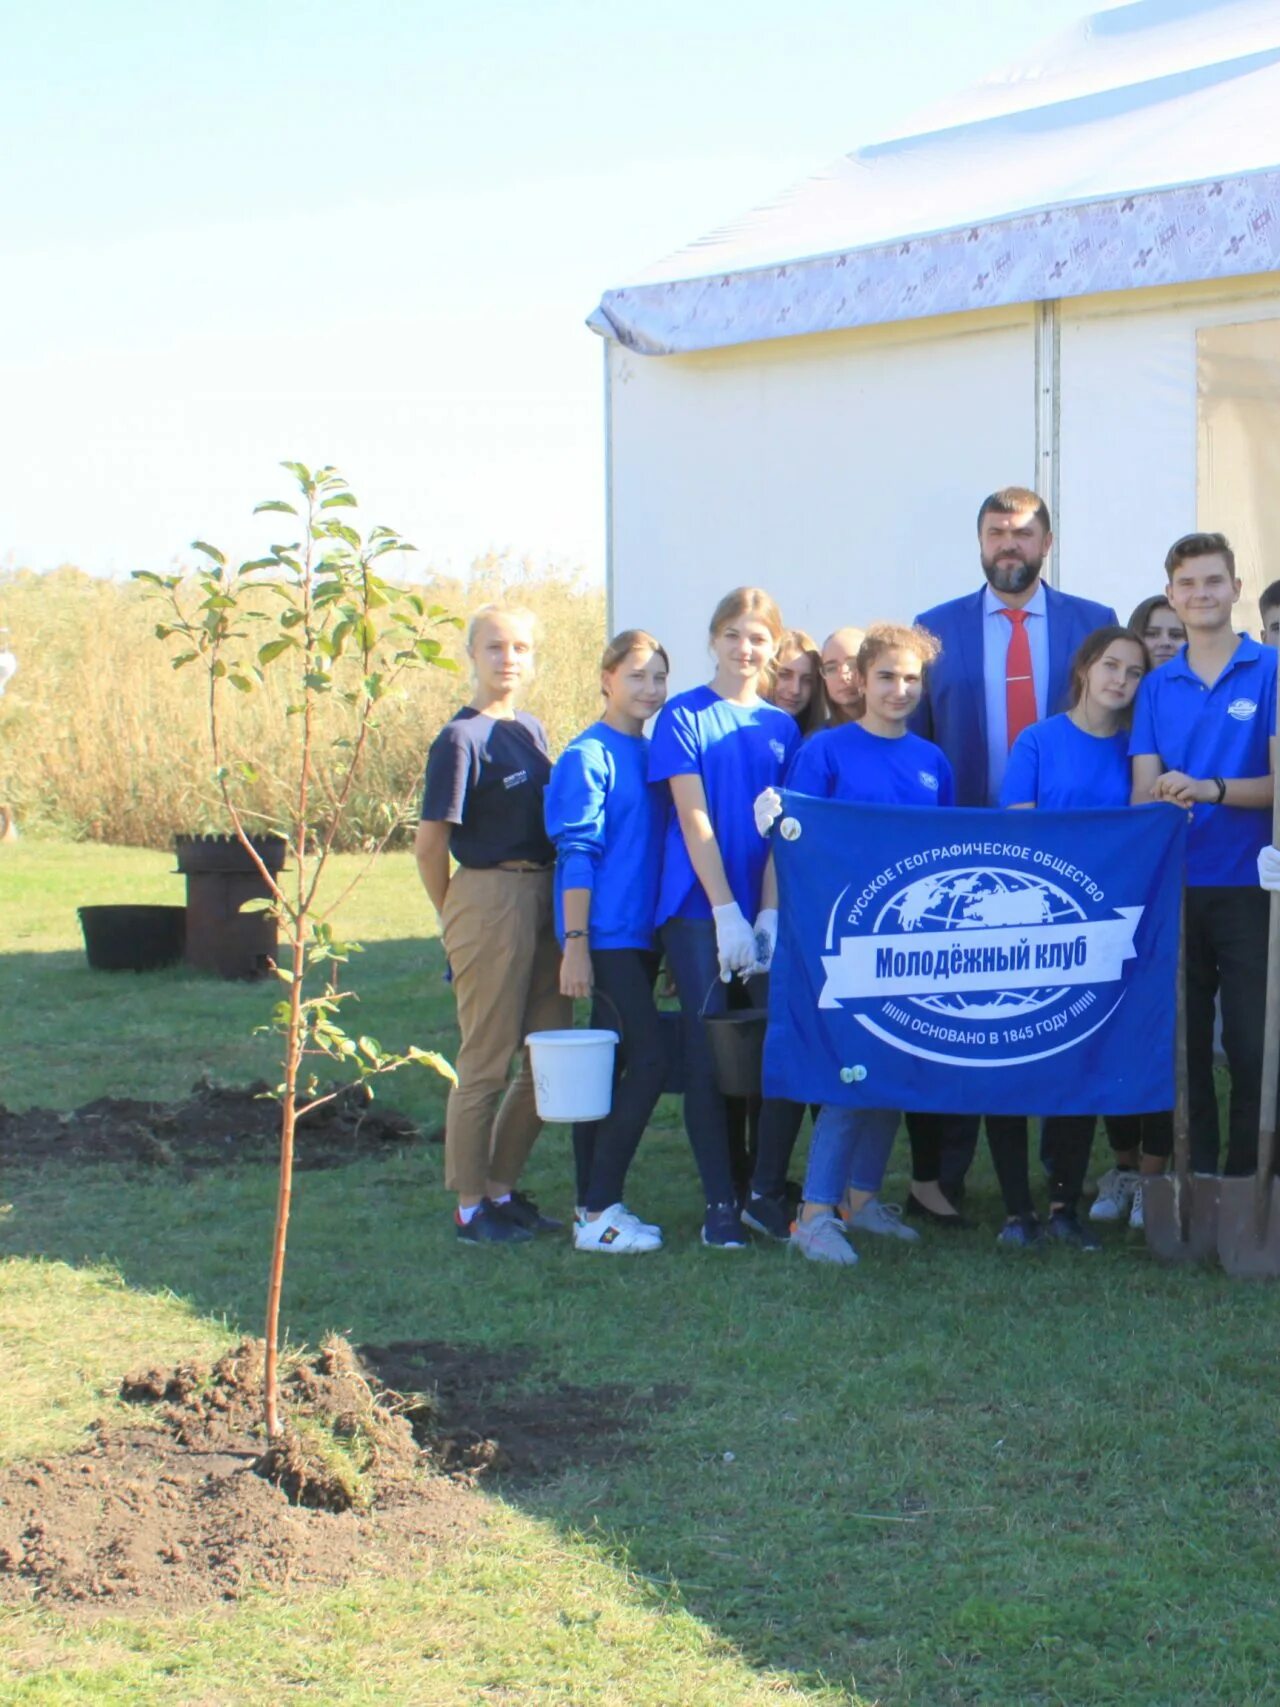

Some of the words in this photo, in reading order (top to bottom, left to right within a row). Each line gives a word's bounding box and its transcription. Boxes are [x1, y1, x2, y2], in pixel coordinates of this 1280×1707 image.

[848, 867, 897, 925] РУССКОЕ
[895, 843, 1031, 875] ГЕОГРАФИЧЕСКОЕ
[1033, 851, 1104, 902] ОБЩЕСТВО
[876, 939, 1031, 979] Молодёжный
[1034, 935, 1087, 968] клуб
[912, 1020, 985, 1045] ОСНОВАНО
[989, 1032, 999, 1044] В
[1003, 1025, 1034, 1043] 1845
[1036, 1011, 1069, 1036] ГОДУ
